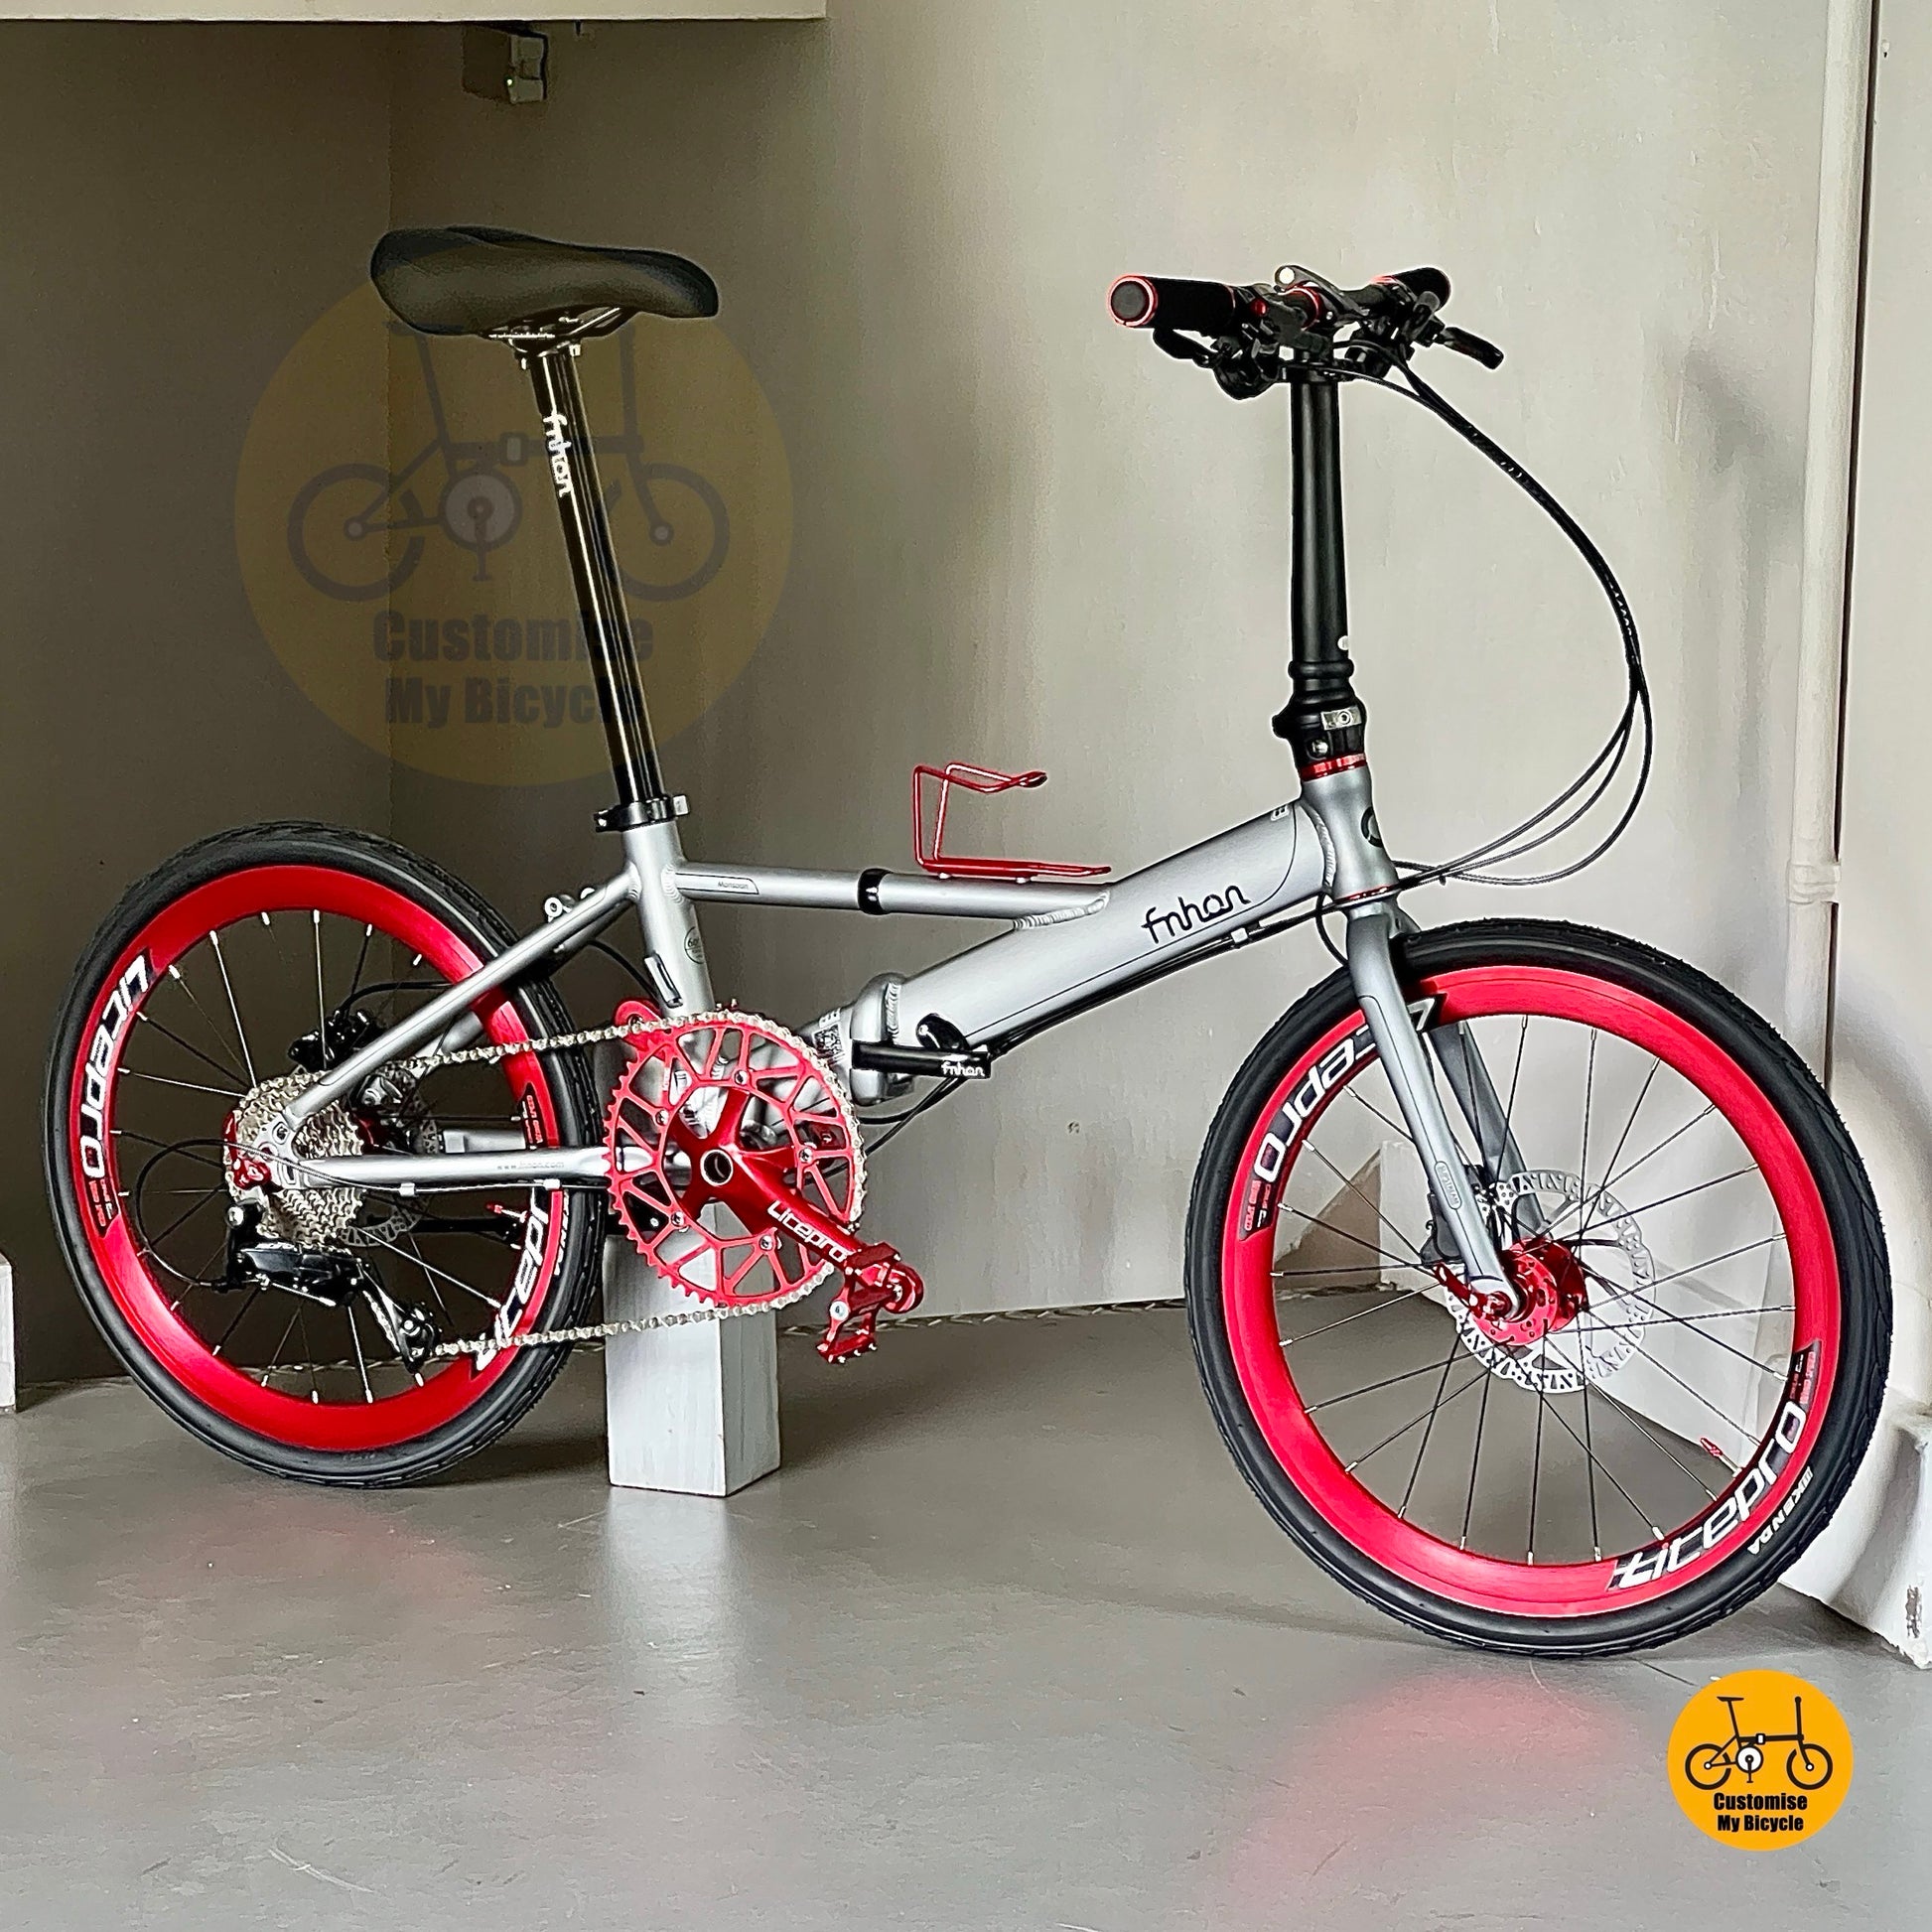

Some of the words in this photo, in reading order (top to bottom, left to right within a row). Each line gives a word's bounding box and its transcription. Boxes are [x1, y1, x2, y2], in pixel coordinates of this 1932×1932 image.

[1141, 885, 1252, 944] fnhon
[941, 1060, 986, 1077] fnhon
[1746, 1473, 1809, 1555] KENDA
